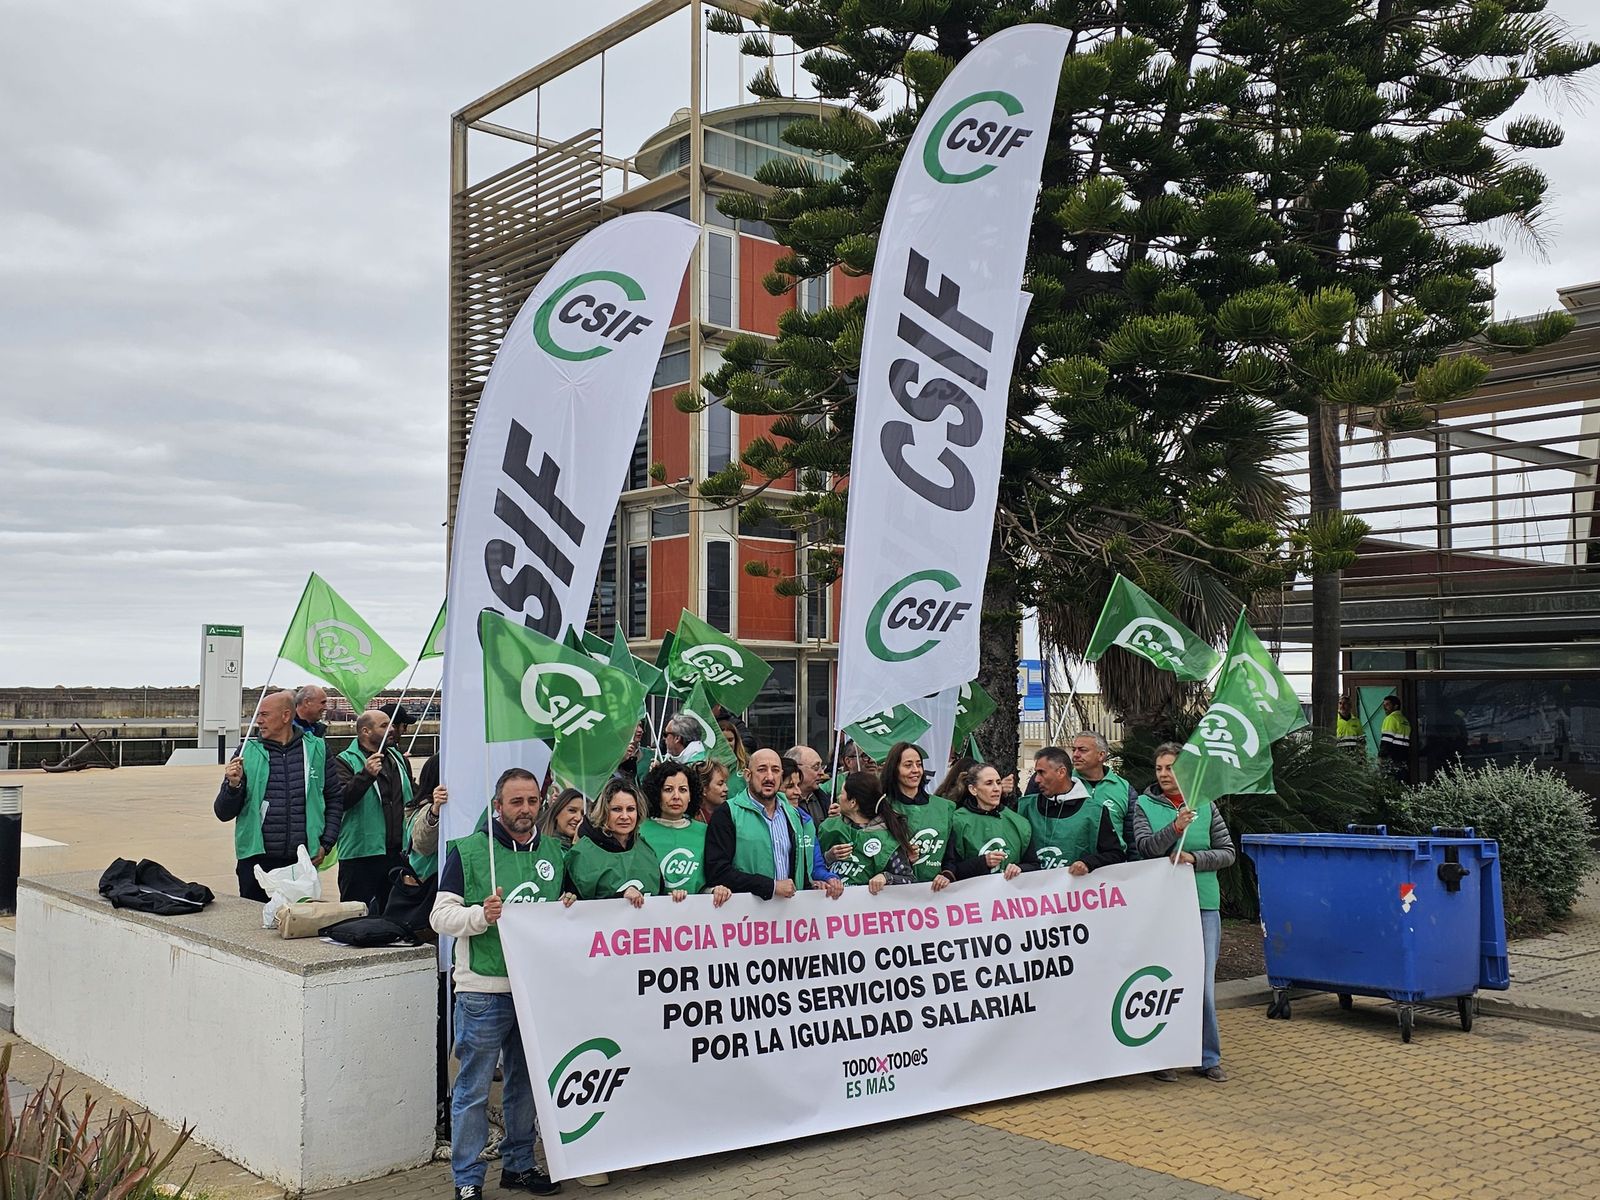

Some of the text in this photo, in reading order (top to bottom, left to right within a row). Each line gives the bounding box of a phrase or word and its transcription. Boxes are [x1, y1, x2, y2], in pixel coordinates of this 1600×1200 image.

[947, 117, 1033, 159] CSIF
[558, 294, 654, 343] CSIF
[880, 247, 994, 511] CSIF
[887, 597, 973, 633] CSIF
[208, 644, 215, 653] 1
[692, 655, 745, 686] CSIF
[1198, 713, 1241, 769] CSIF
[667, 858, 700, 876] CSIF
[589, 883, 1127, 957] AGENCIA PÚBLICA PUERTOS DE ANDALUCÍA
[638, 923, 1090, 996] POR UN CONVENIO COLECTIVO JUSTO
[663, 955, 1074, 1030] POR UNOS SERVICIOS DE CALIDAD
[1125, 987, 1184, 1021] CSIF
[692, 991, 1037, 1064] POR LA IGUALDAD SALARIAL
[556, 1066, 631, 1110] CSIF
[846, 1072, 896, 1099] ES MÁS
